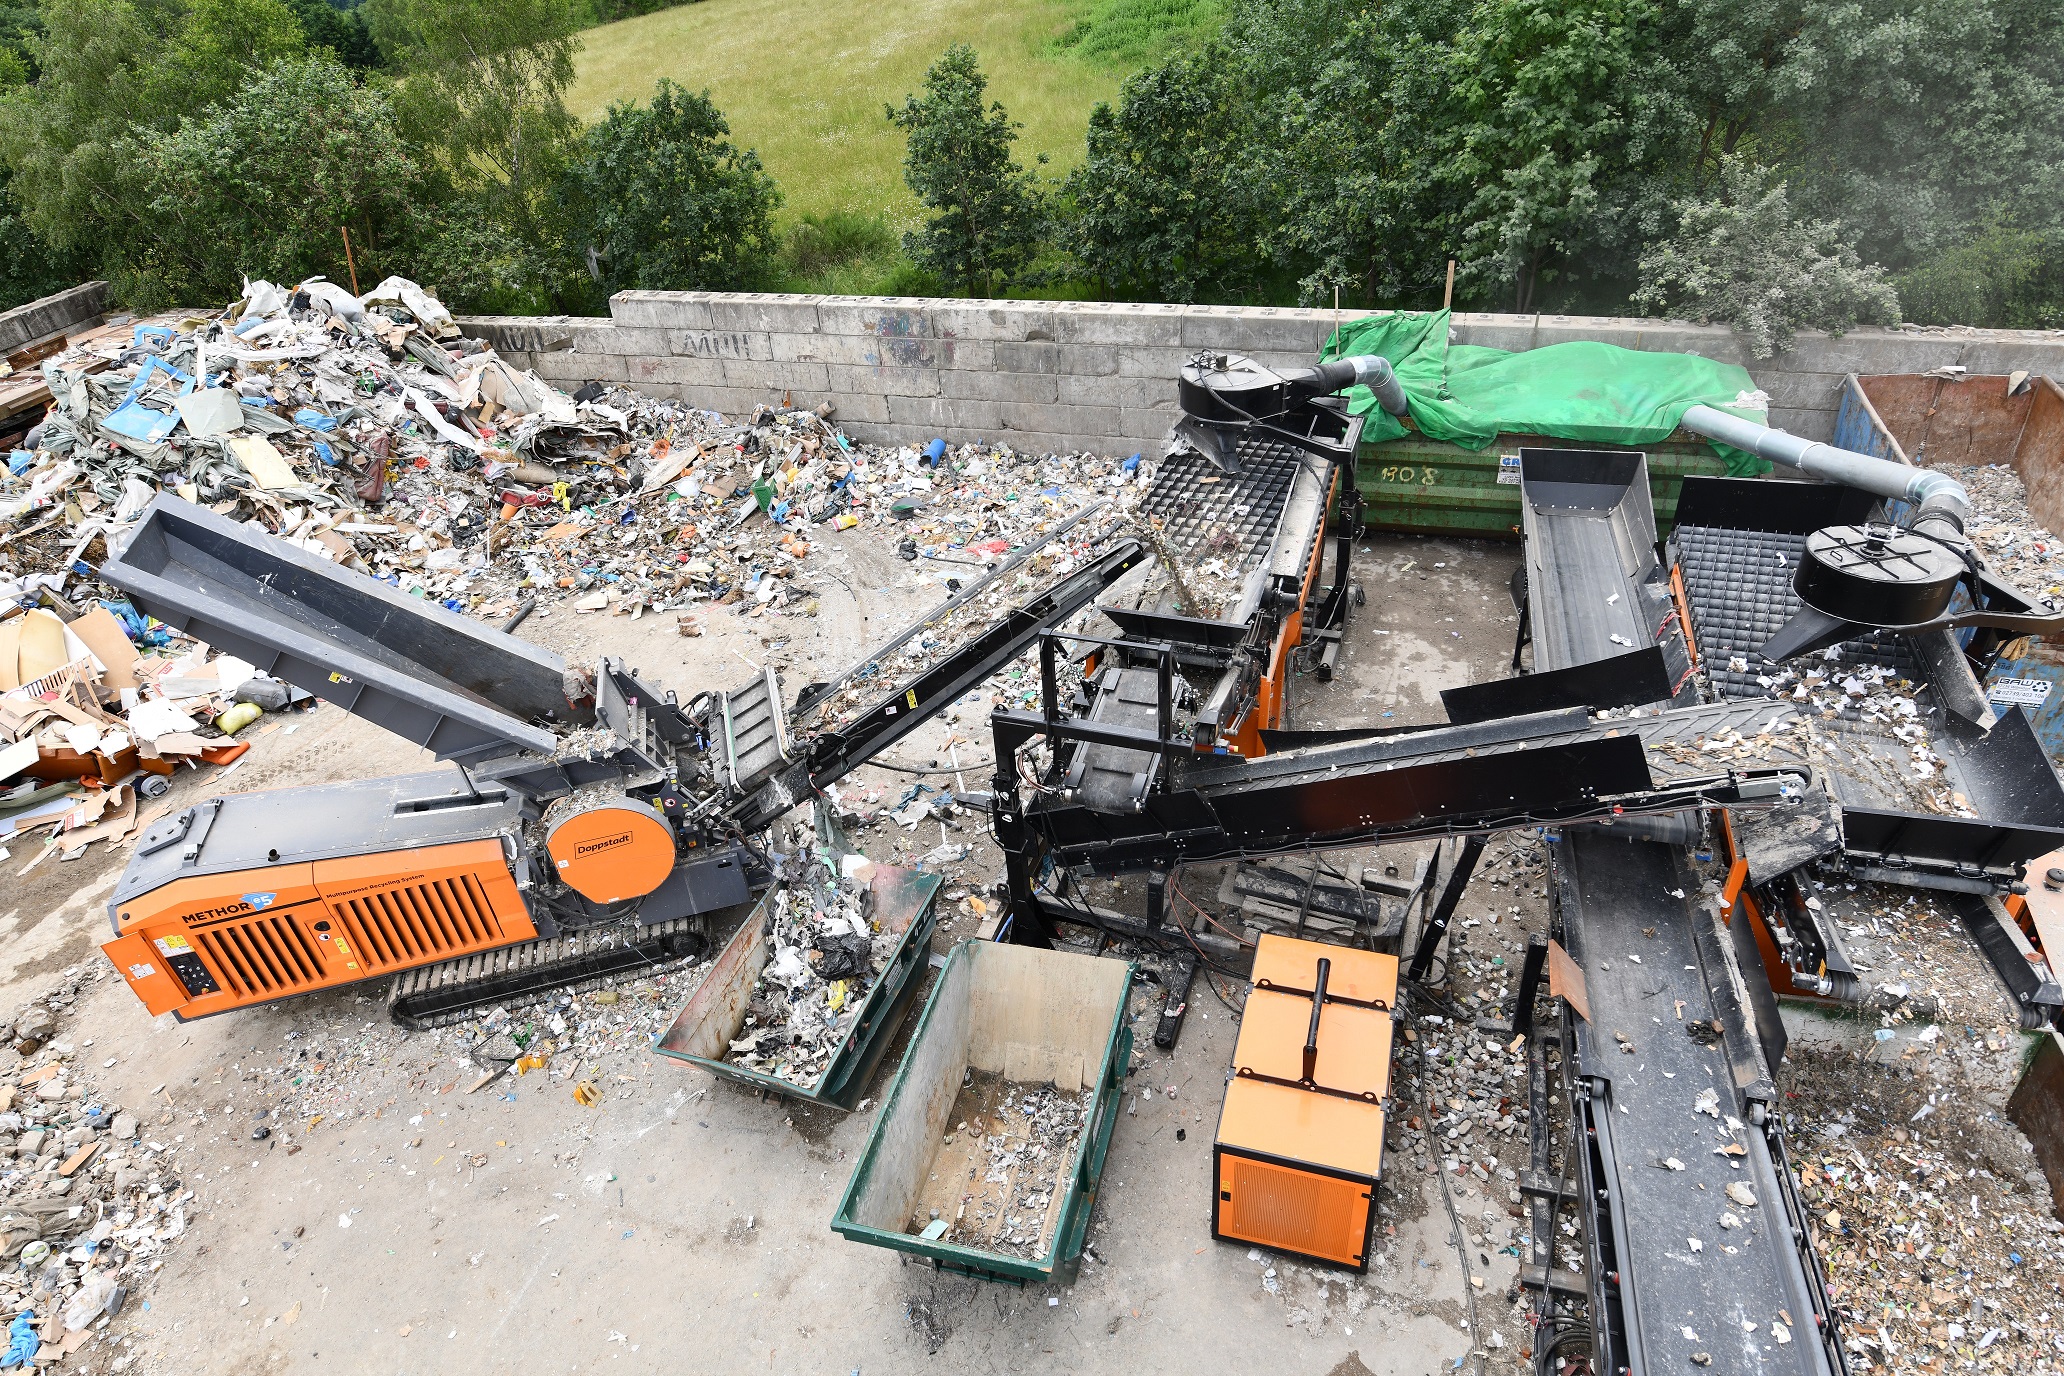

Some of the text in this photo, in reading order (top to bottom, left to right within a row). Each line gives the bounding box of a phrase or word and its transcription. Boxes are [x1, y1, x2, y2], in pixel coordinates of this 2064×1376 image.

[1999, 678, 2034, 686] BAW
[578, 835, 630, 854] Doppstadt
[326, 873, 425, 899] Multipurpose Recycling System
[181, 895, 273, 924] METHOR e5
